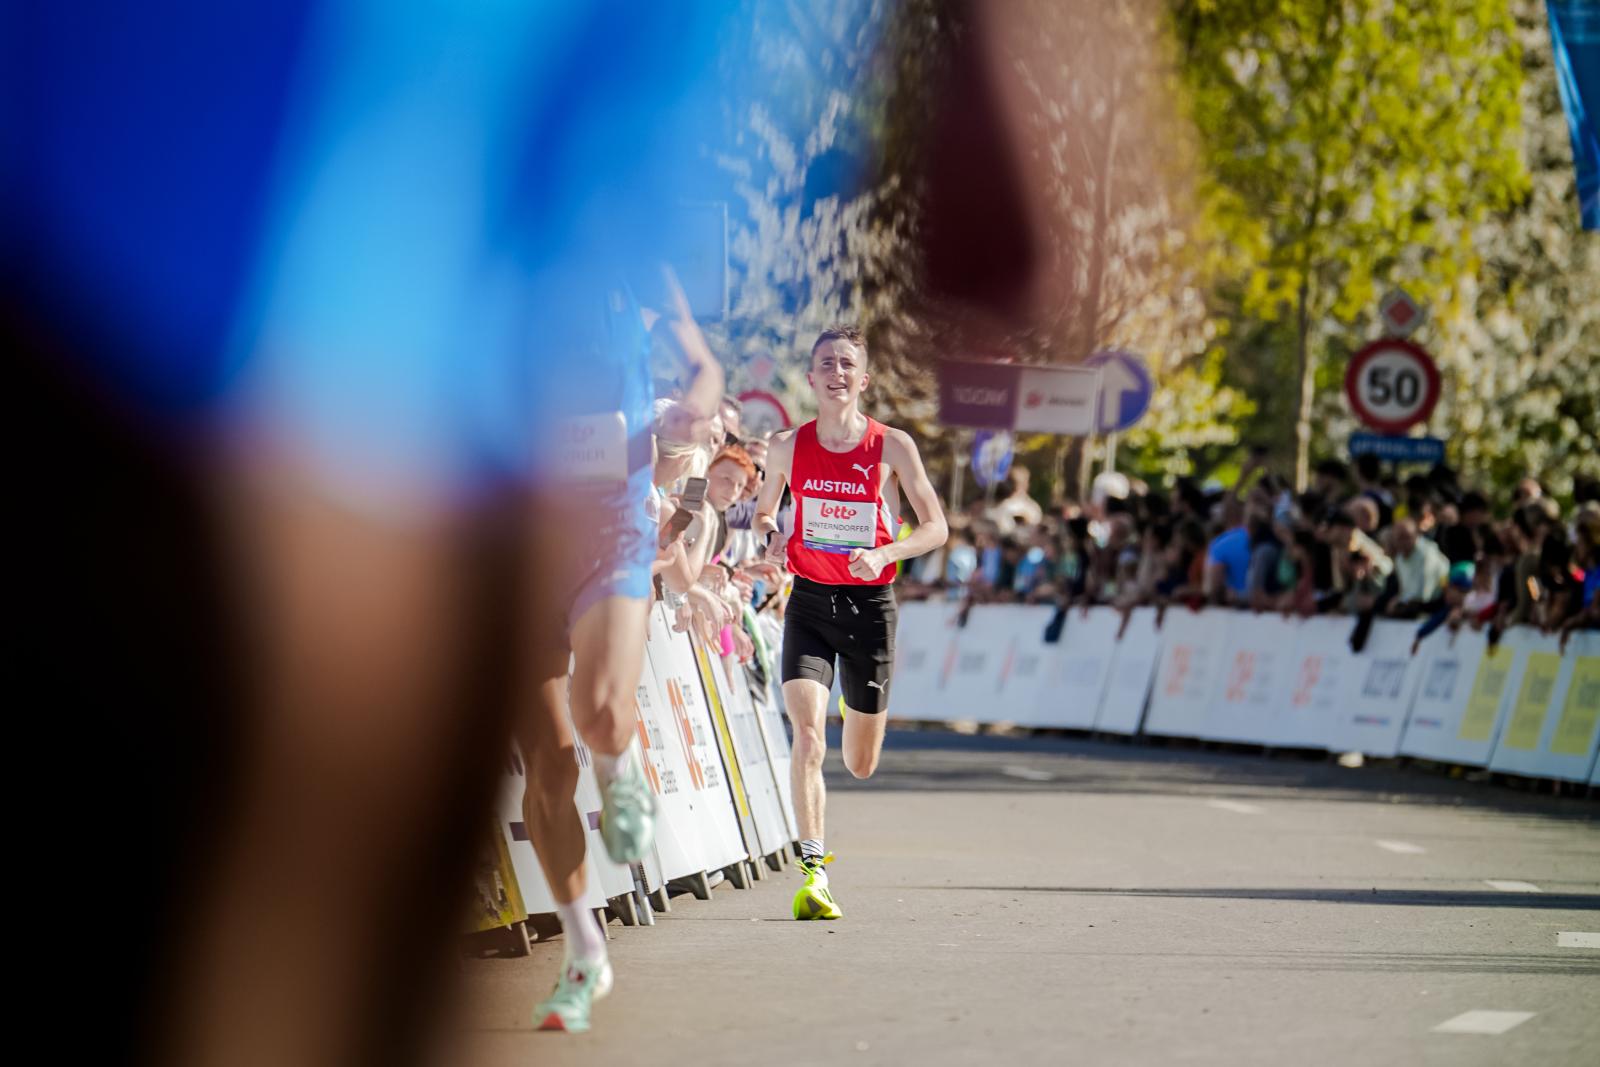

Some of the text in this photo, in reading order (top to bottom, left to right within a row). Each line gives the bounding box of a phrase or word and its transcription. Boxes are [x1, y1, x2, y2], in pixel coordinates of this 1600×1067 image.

[1368, 367, 1420, 407] 50
[803, 479, 866, 495] AUSTRIA
[808, 522, 869, 532] HINTERNDORFER
